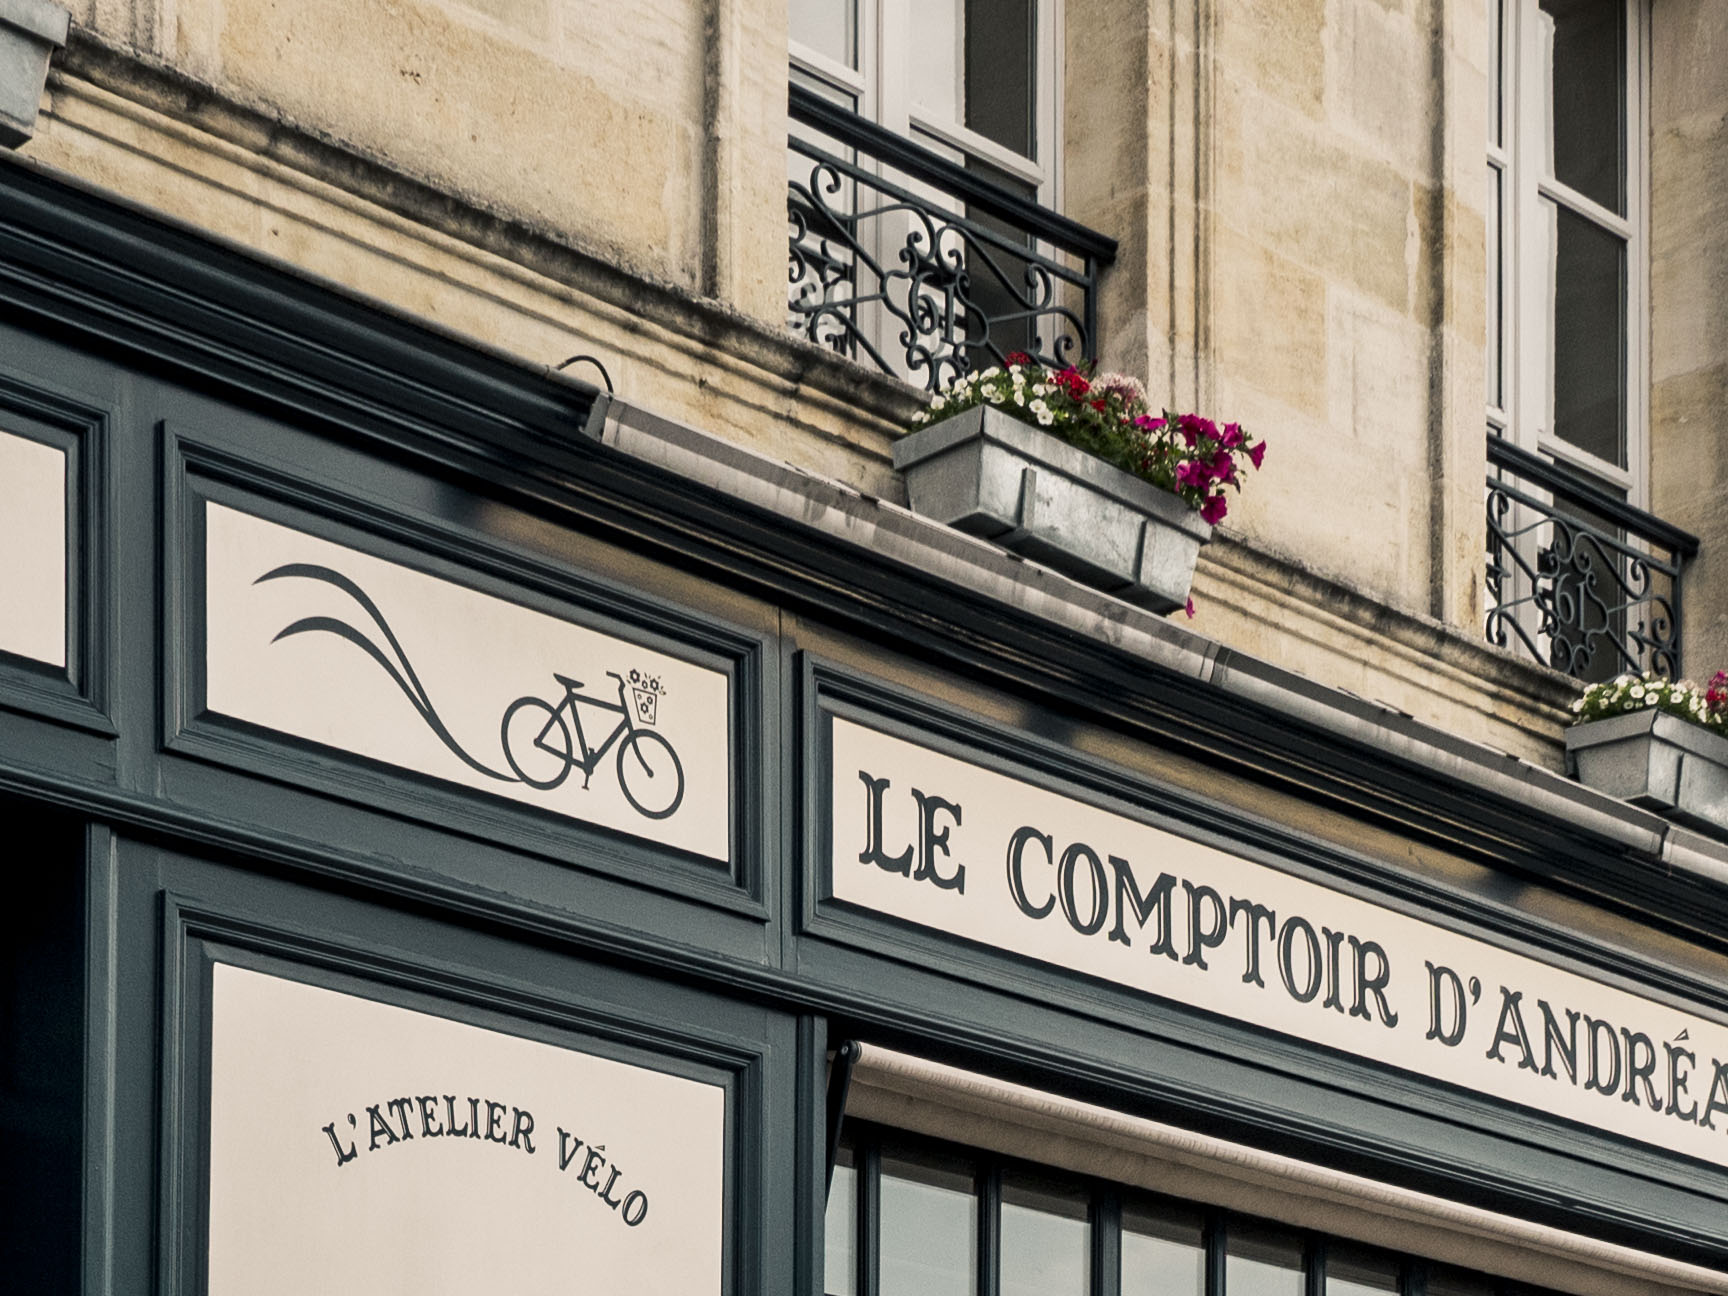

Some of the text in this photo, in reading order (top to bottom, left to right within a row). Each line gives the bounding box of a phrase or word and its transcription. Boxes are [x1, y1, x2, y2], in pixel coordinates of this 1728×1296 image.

[858, 769, 967, 896] LE
[1006, 825, 1400, 1029] COMPTOIR
[321, 1094, 649, 1227] L'ATELIER VÉLO
